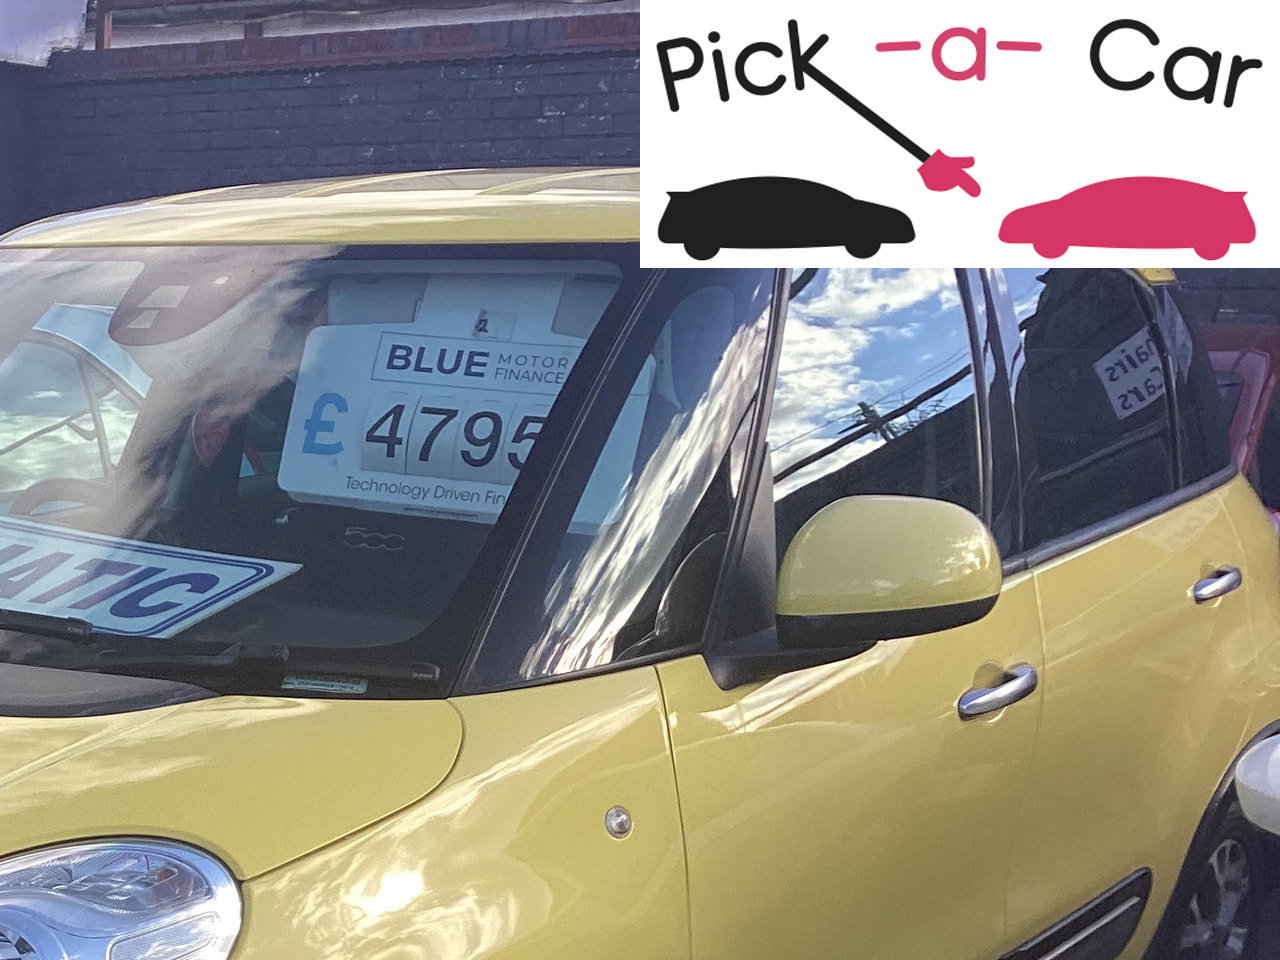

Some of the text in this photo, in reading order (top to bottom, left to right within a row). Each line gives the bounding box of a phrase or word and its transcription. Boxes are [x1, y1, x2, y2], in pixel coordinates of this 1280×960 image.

[386, 345, 568, 378] BLUE MOTOR
[493, 367, 564, 385] FINANCE
[345, 476, 430, 500] Technology
[433, 485, 480, 503] Driven
